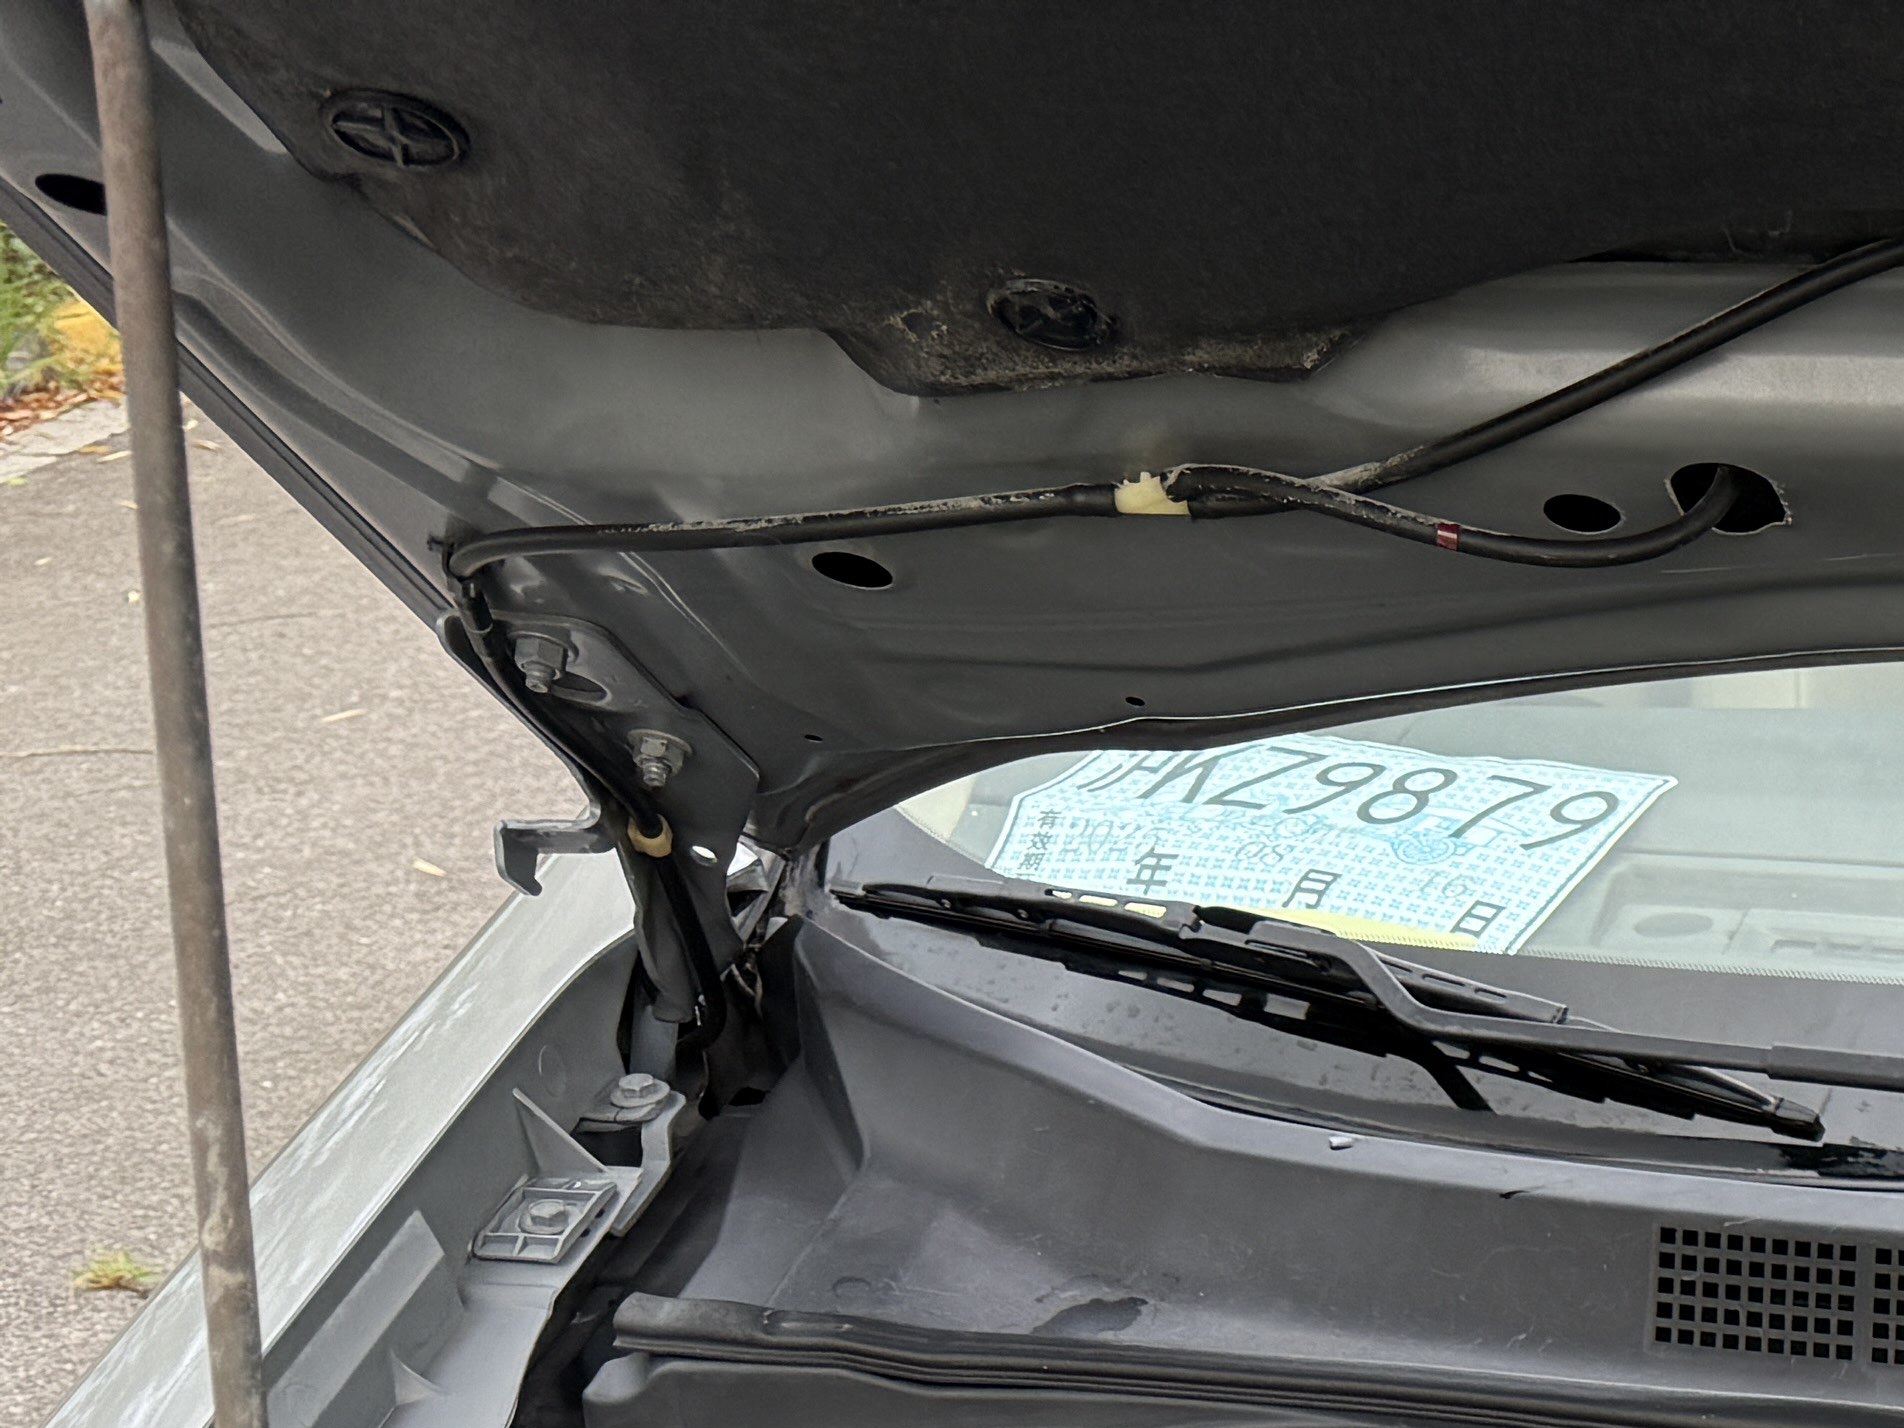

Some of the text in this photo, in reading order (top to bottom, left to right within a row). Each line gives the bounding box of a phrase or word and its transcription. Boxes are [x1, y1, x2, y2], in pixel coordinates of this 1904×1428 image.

[1126, 848, 1179, 895] 年
[1281, 868, 1343, 910] 月
[1449, 899, 1506, 938] 日
